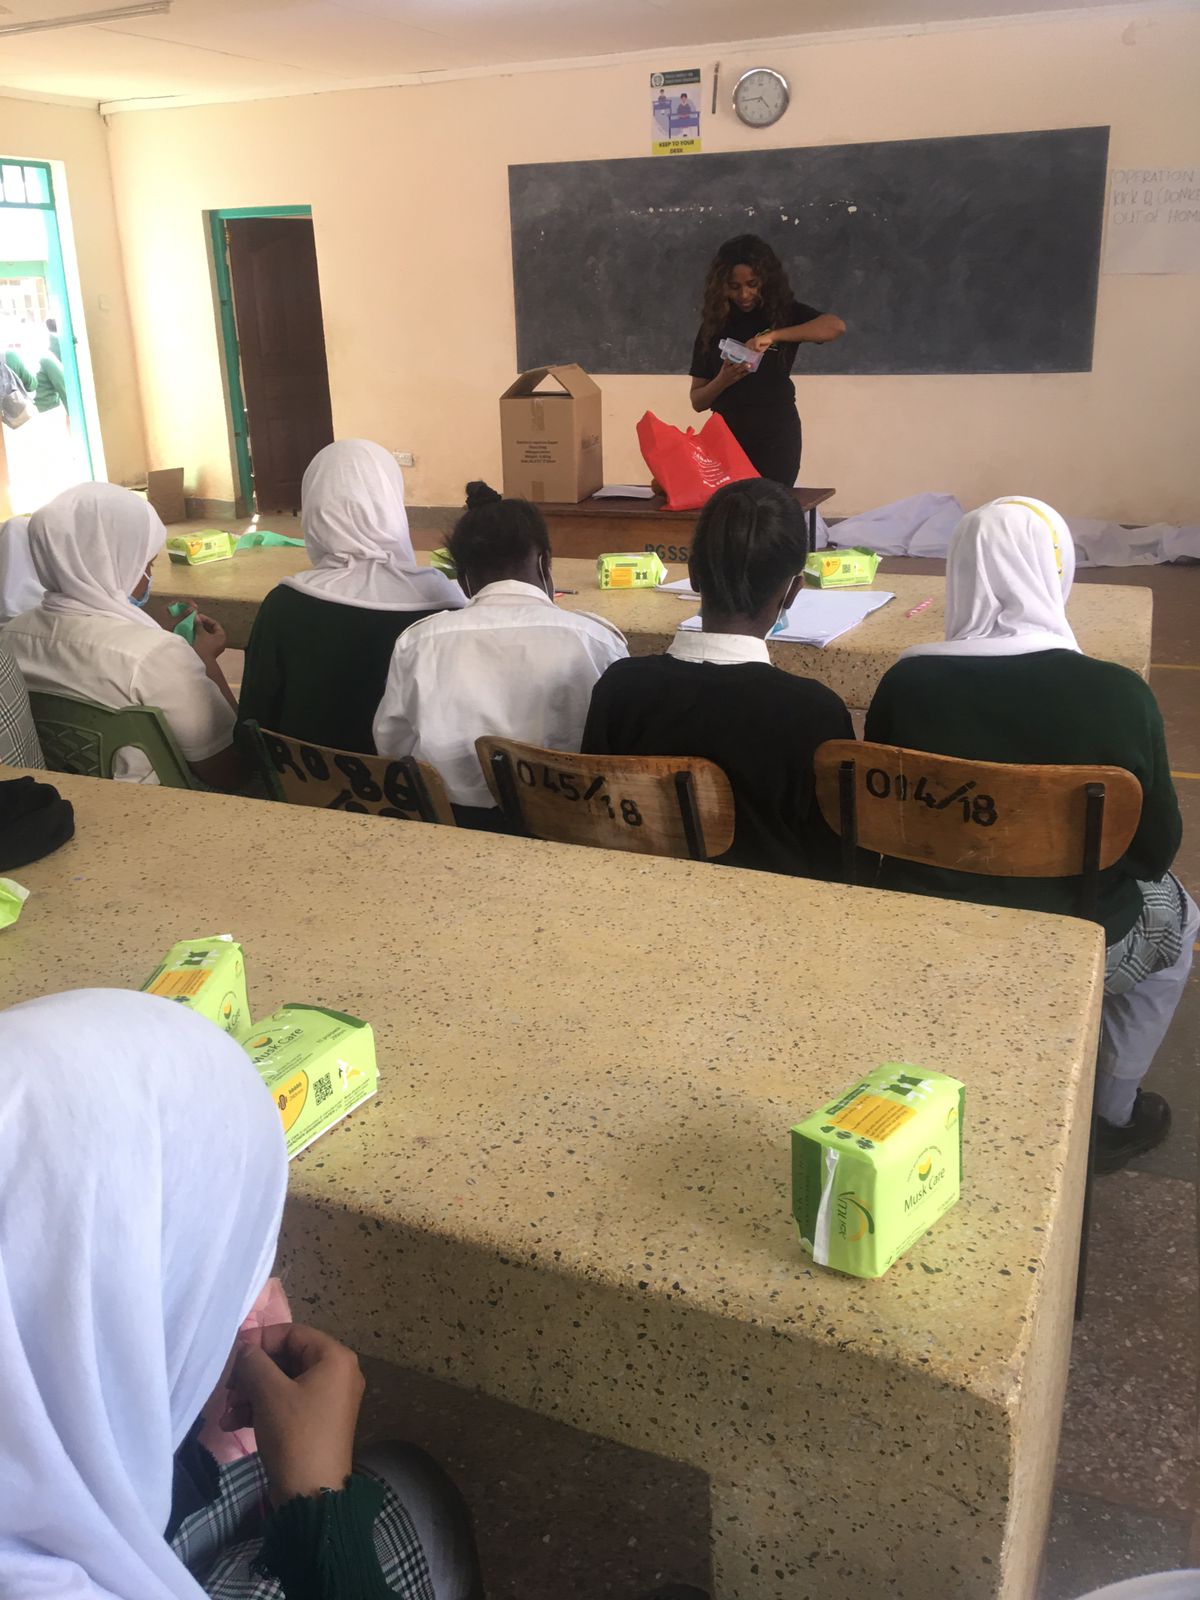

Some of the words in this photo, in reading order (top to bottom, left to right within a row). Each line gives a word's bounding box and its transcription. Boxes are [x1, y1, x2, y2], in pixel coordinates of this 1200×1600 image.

[866, 768, 998, 827] 014/18
[278, 1028, 304, 1045] Care
[904, 1183, 927, 1213] Musk
[928, 1167, 946, 1190] Care
